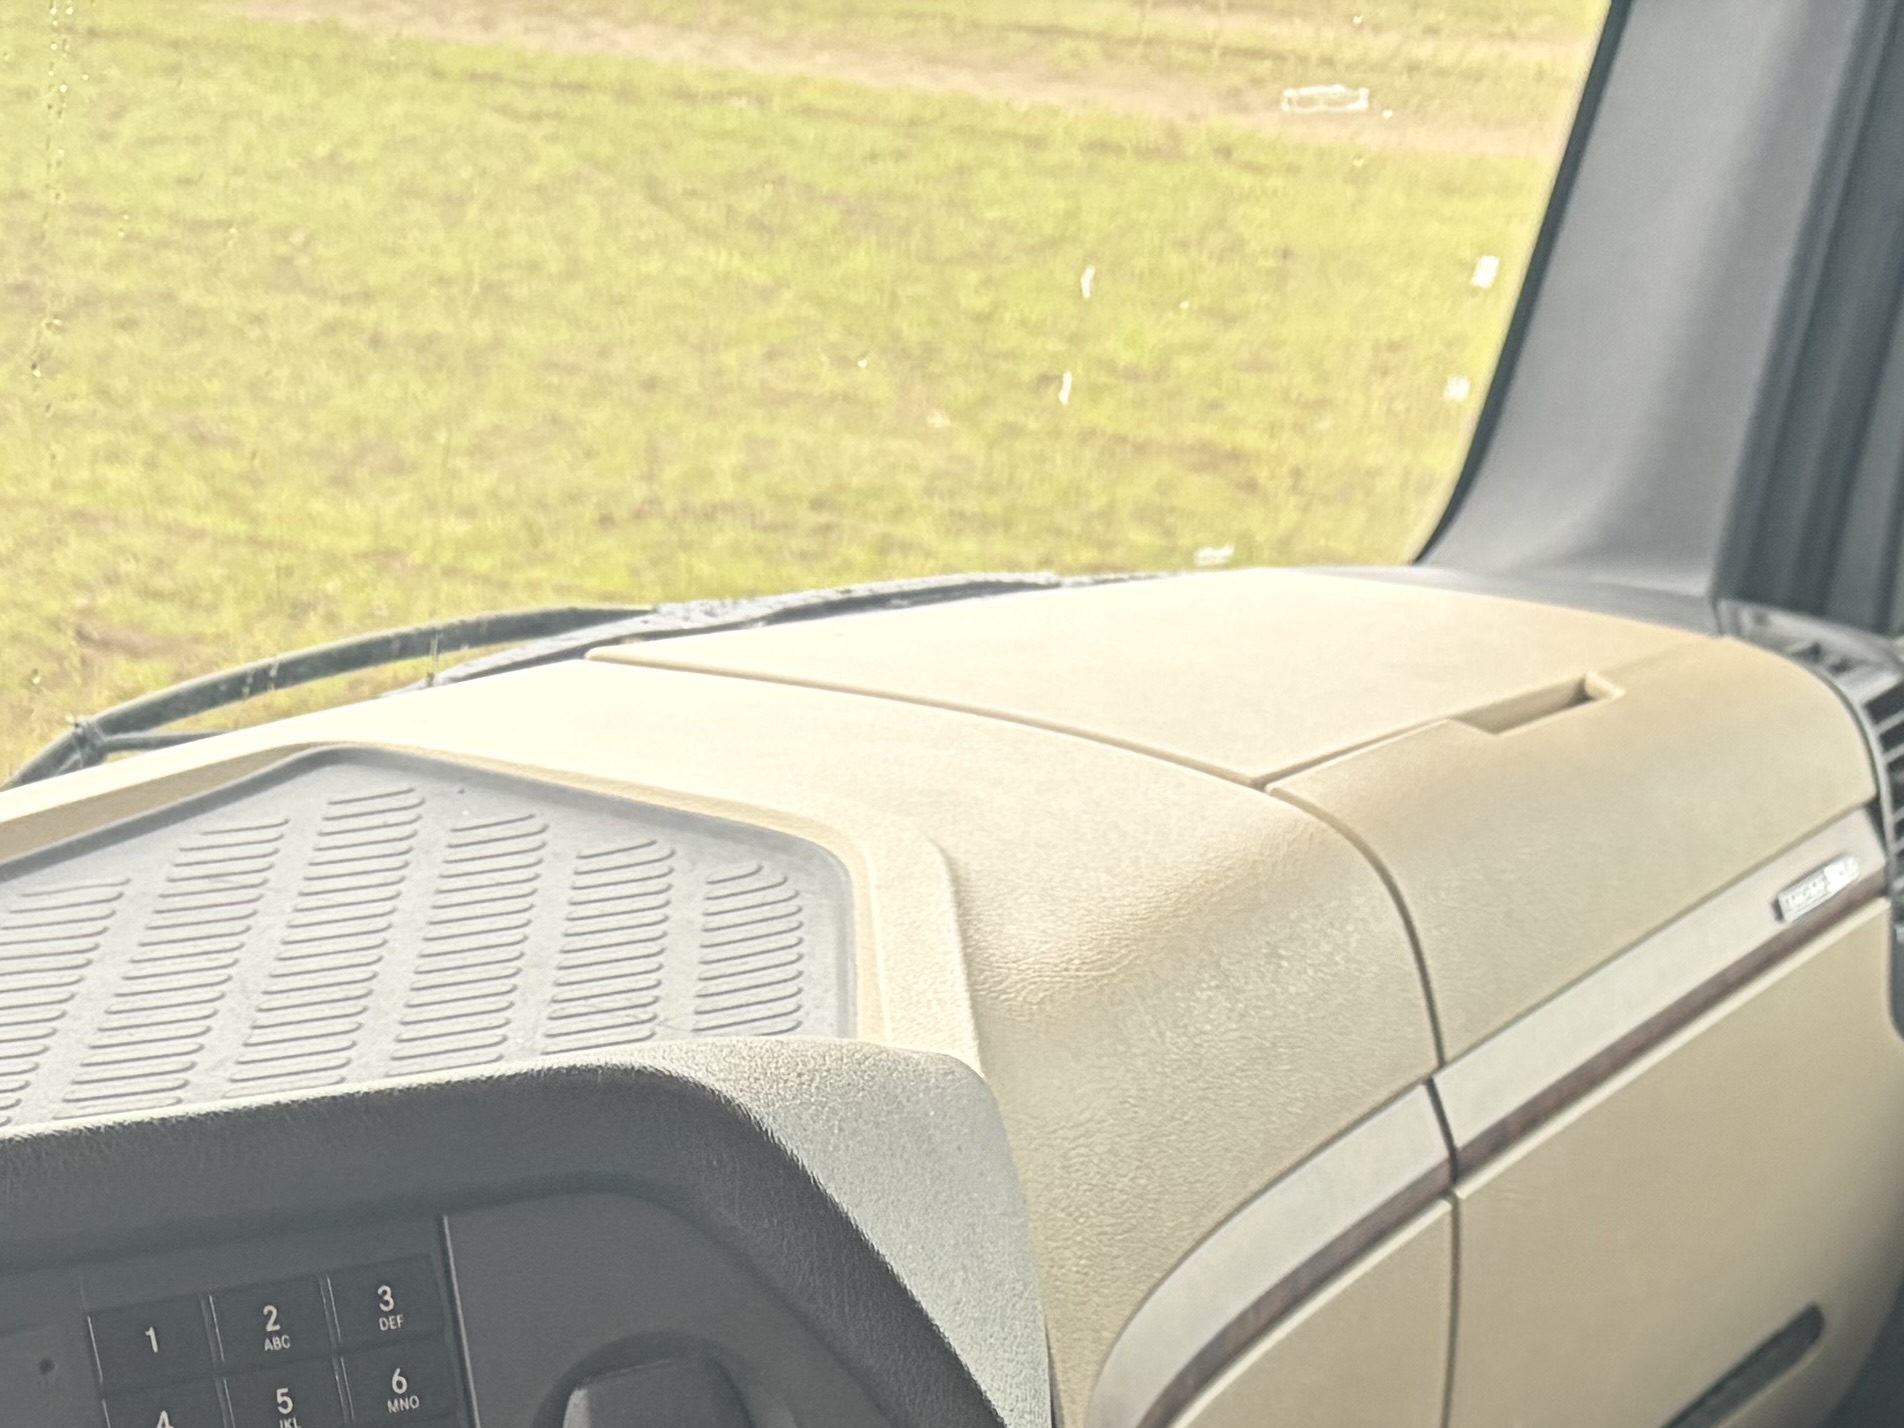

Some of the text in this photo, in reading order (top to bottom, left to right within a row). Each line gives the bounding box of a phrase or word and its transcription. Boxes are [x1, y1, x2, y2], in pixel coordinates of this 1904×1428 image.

[377, 1285, 395, 1312] 3
[263, 1305, 281, 1332] 2
[379, 1314, 404, 1331] DEF
[145, 1326, 159, 1353] 1
[264, 1335, 291, 1351] ABC
[392, 1368, 408, 1394] 6
[276, 1388, 294, 1415] 5
[387, 1395, 420, 1414] MNO
